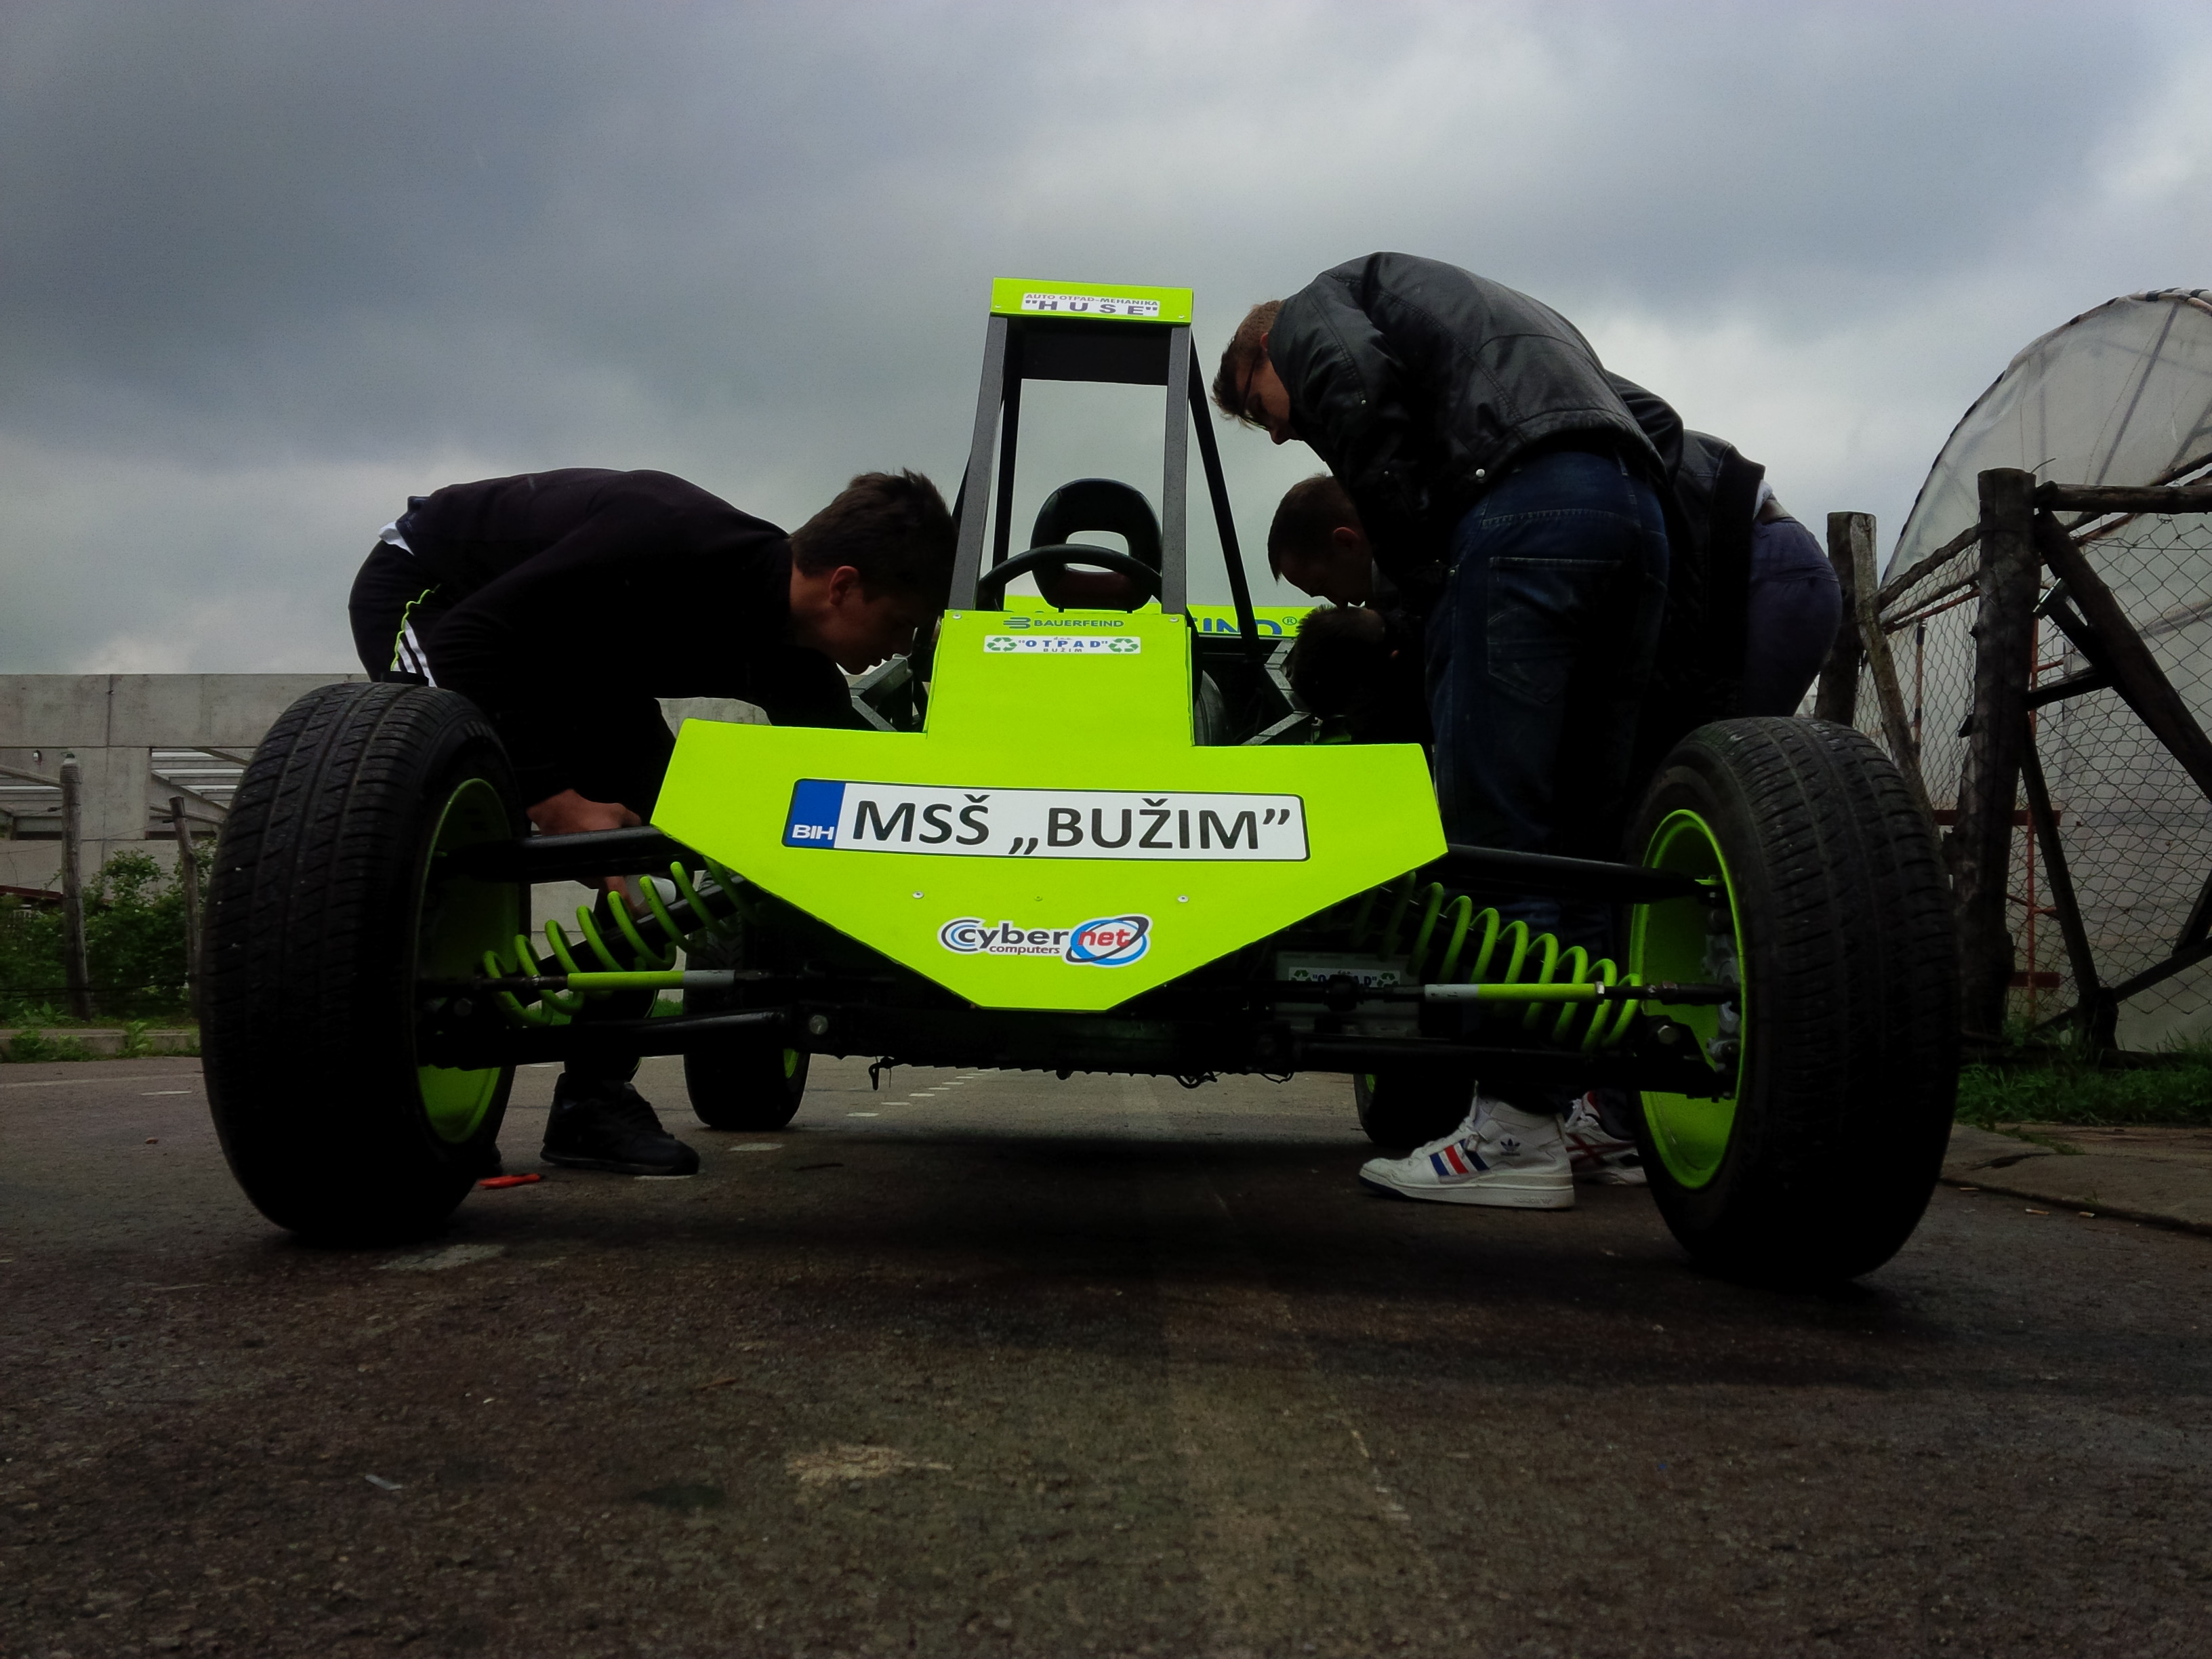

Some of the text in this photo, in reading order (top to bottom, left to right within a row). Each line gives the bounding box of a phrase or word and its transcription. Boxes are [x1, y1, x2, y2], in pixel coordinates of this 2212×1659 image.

[1033, 619, 1125, 628] BAUERFEIND
[852, 794, 991, 846] MSŠ
[792, 823, 835, 841] BIH
[989, 944, 1061, 956] computers
